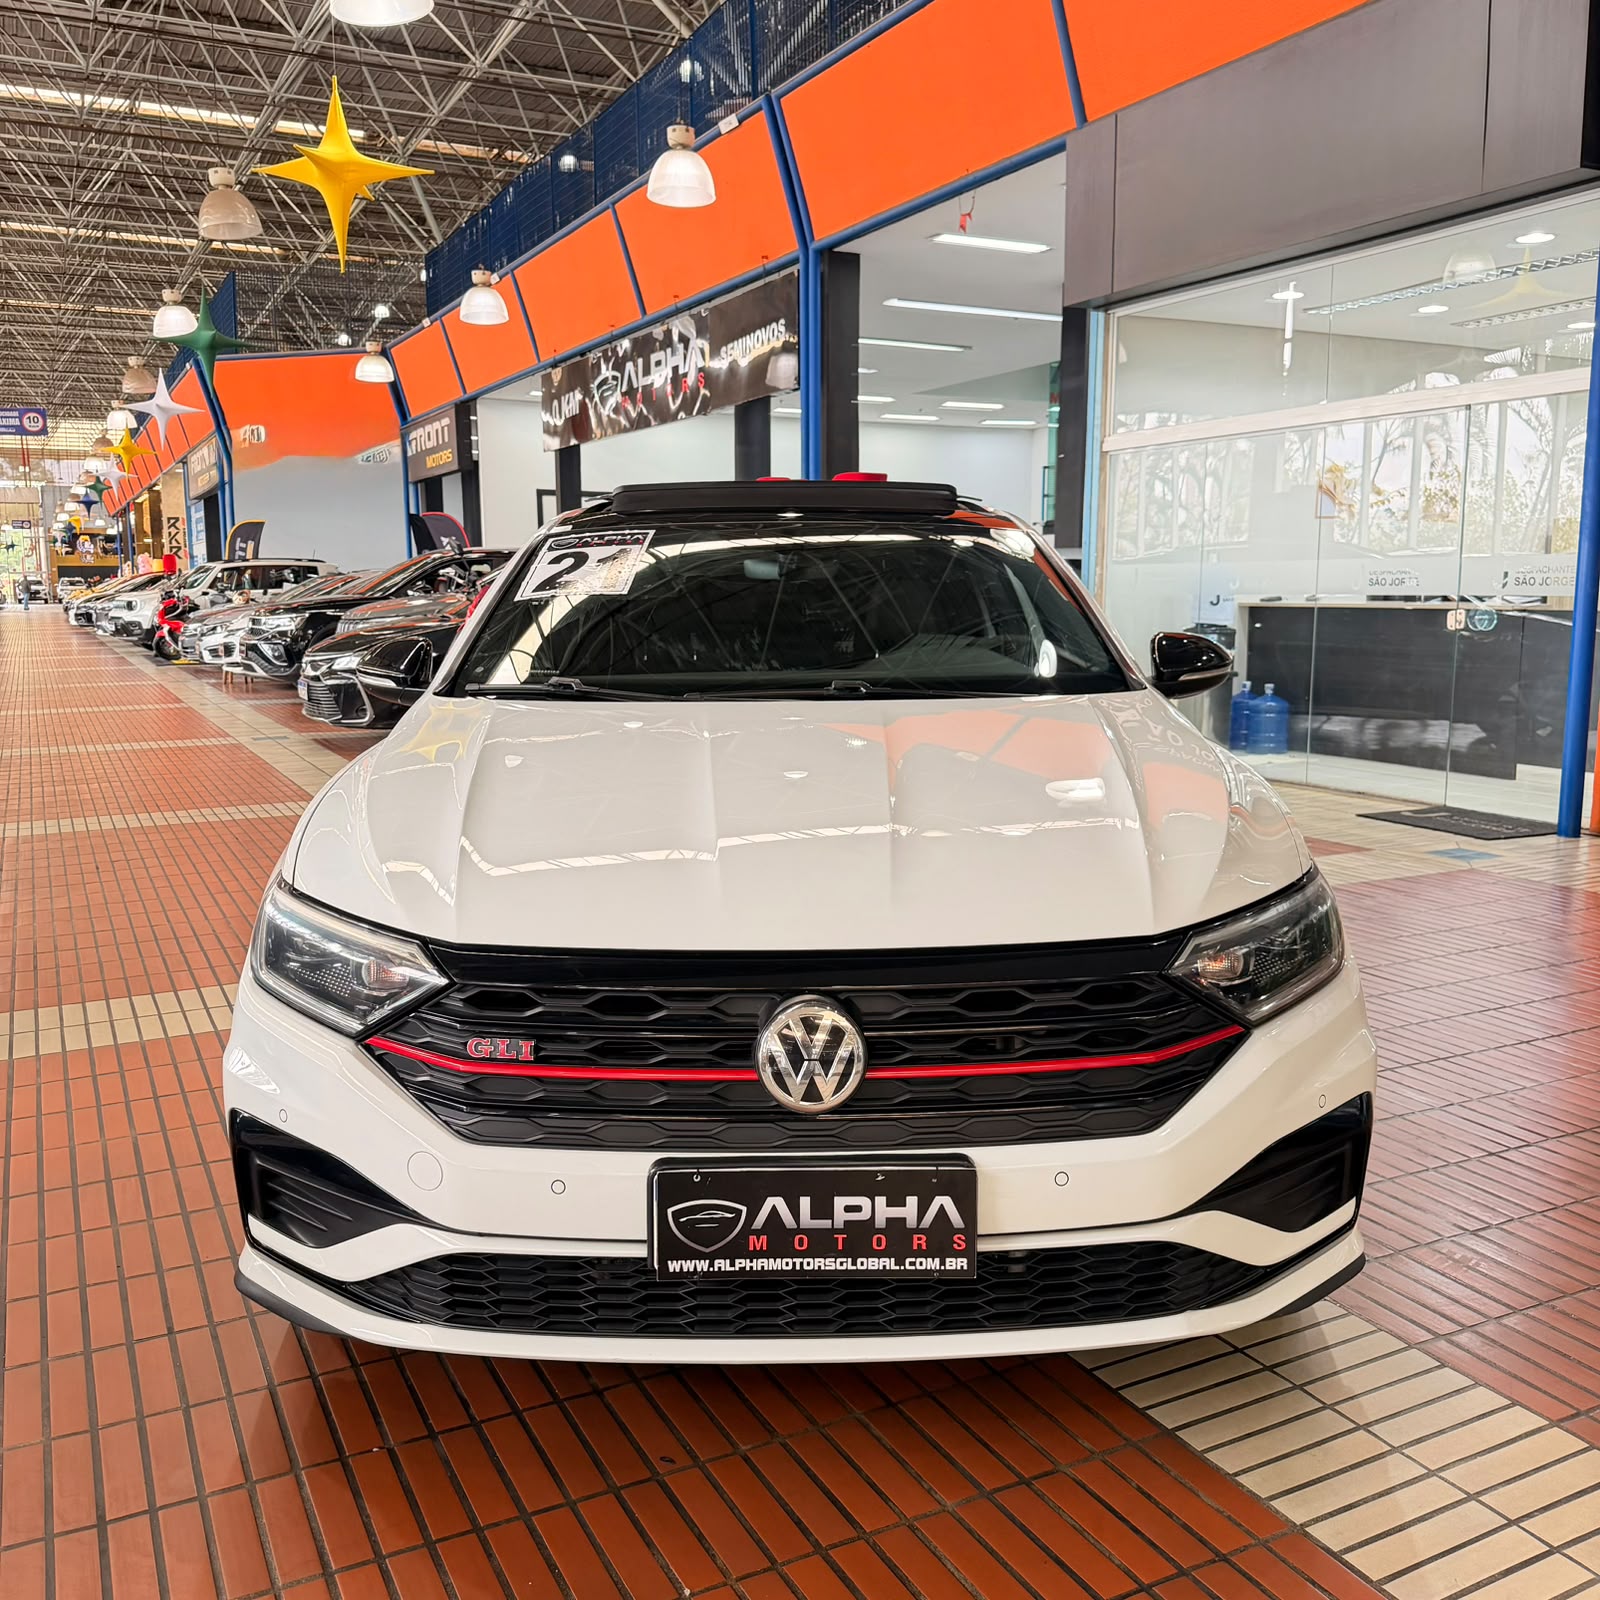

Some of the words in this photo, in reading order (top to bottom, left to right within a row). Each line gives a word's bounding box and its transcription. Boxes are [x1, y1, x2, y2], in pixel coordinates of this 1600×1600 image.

[719, 319, 786, 361] SEMINOVOS
[621, 338, 706, 392] ALPHA
[26, 416, 40, 424] 10
[407, 417, 450, 457] FRONT
[426, 449, 453, 468] MOTORS
[578, 534, 645, 545] ALPHA
[1514, 574, 1536, 587] SÃO
[1538, 576, 1575, 587] JORGE
[466, 1037, 536, 1061] GLI
[751, 1195, 966, 1229] ALPHA
[748, 1234, 967, 1251] MOTORS
[667, 1257, 968, 1273] WWW.ALPHAMOTORSGLOBAL.COM.BR
